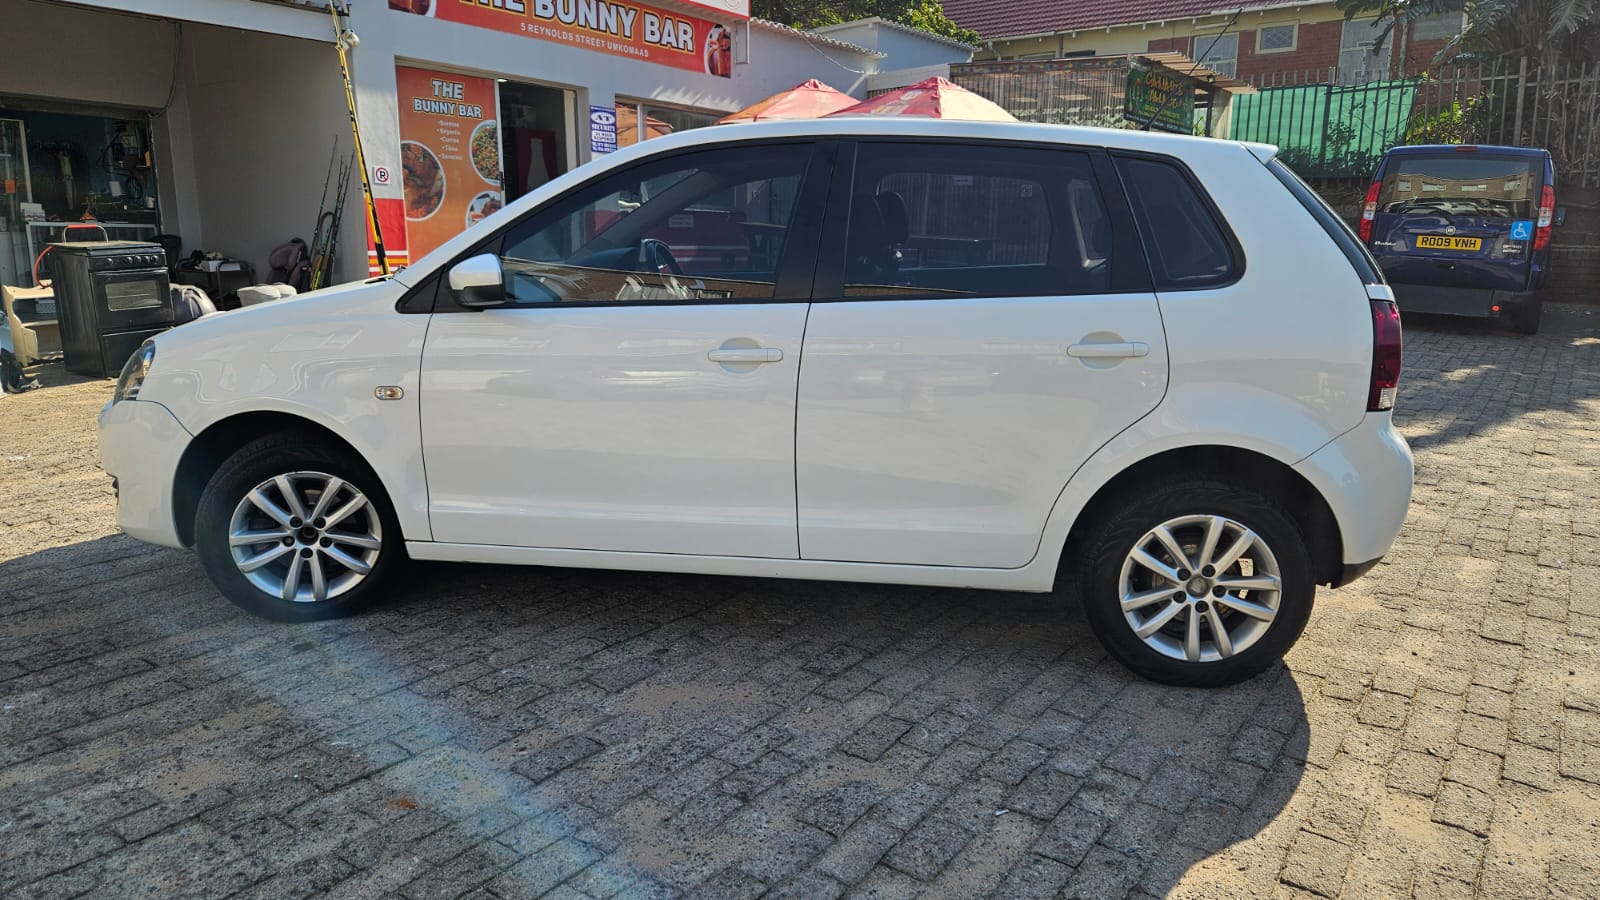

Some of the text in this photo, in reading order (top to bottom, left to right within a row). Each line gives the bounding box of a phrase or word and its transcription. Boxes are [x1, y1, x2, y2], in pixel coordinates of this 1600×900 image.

[535, 0, 694, 53] BUNNY BAR
[528, 24, 573, 41] REYNOLDS
[575, 34, 605, 47] STREET
[607, 42, 649, 57] UMKOMAAS
[432, 79, 464, 100] THE
[413, 97, 483, 119] BUNNY BAR
[1454, 237, 1477, 248] VNH
